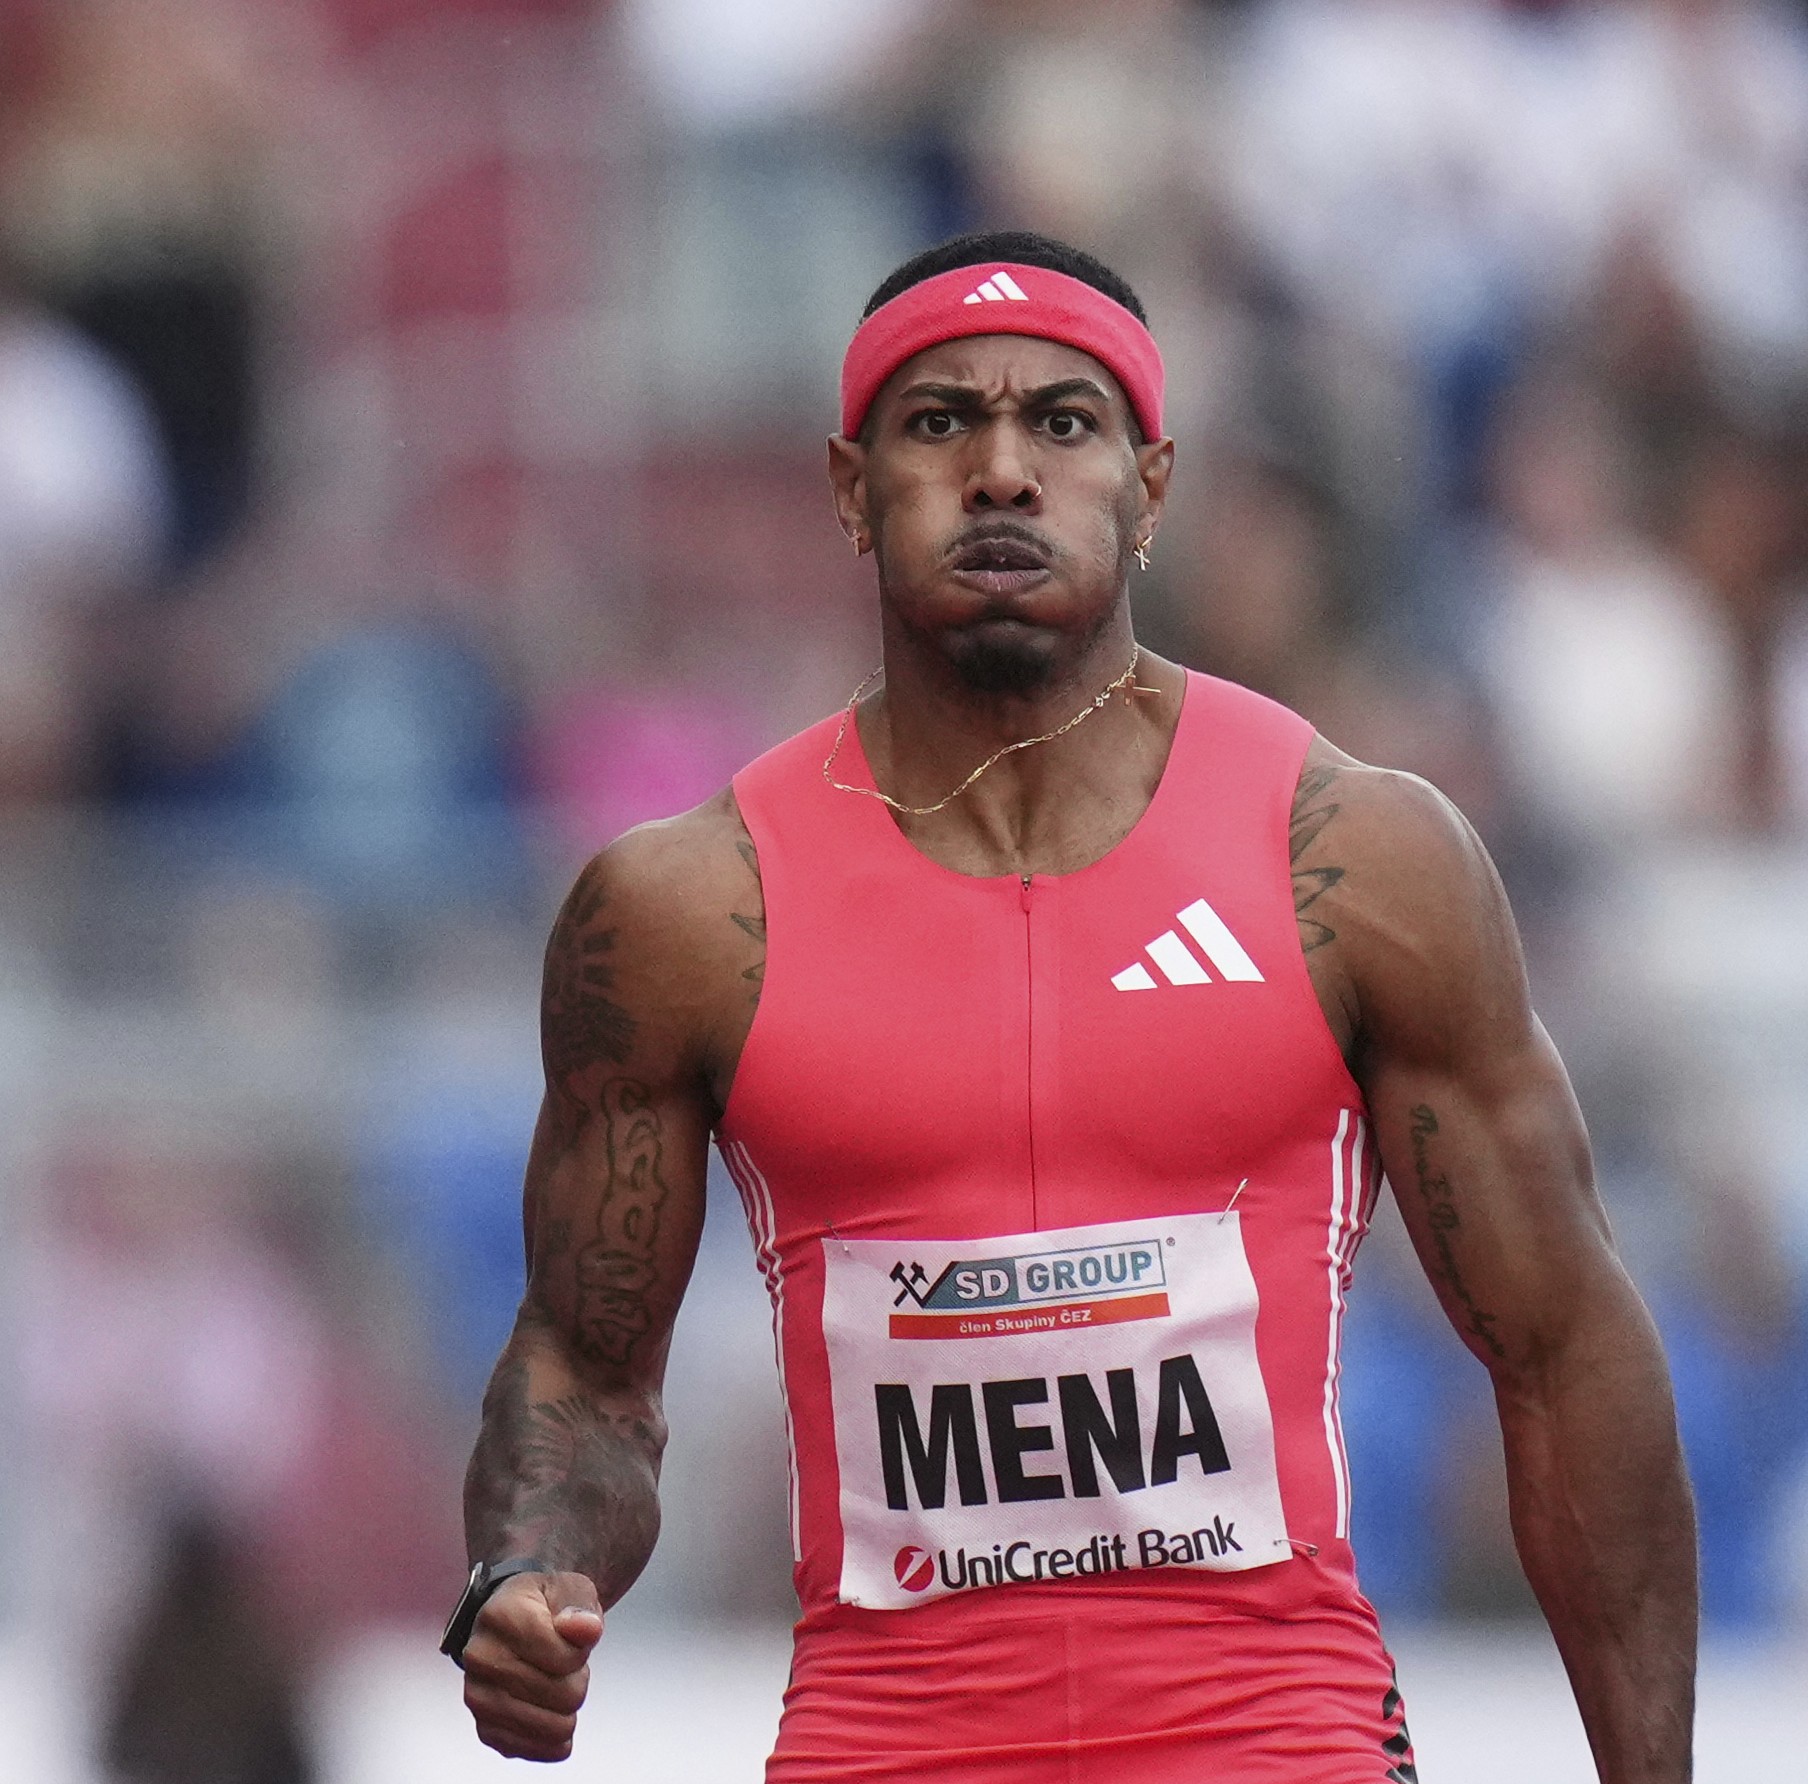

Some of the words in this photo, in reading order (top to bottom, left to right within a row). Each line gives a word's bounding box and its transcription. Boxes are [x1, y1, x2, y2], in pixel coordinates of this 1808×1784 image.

[955, 1268, 1010, 1300] SD
[1026, 1250, 1152, 1293] GROUP
[959, 1320, 991, 1334] člen
[995, 1314, 1056, 1331] Skupiny
[1060, 1309, 1092, 1324] ČEZ
[874, 1354, 1232, 1511] MENA
[938, 1529, 1127, 1591] UniCredit
[1137, 1514, 1244, 1569] Bank
